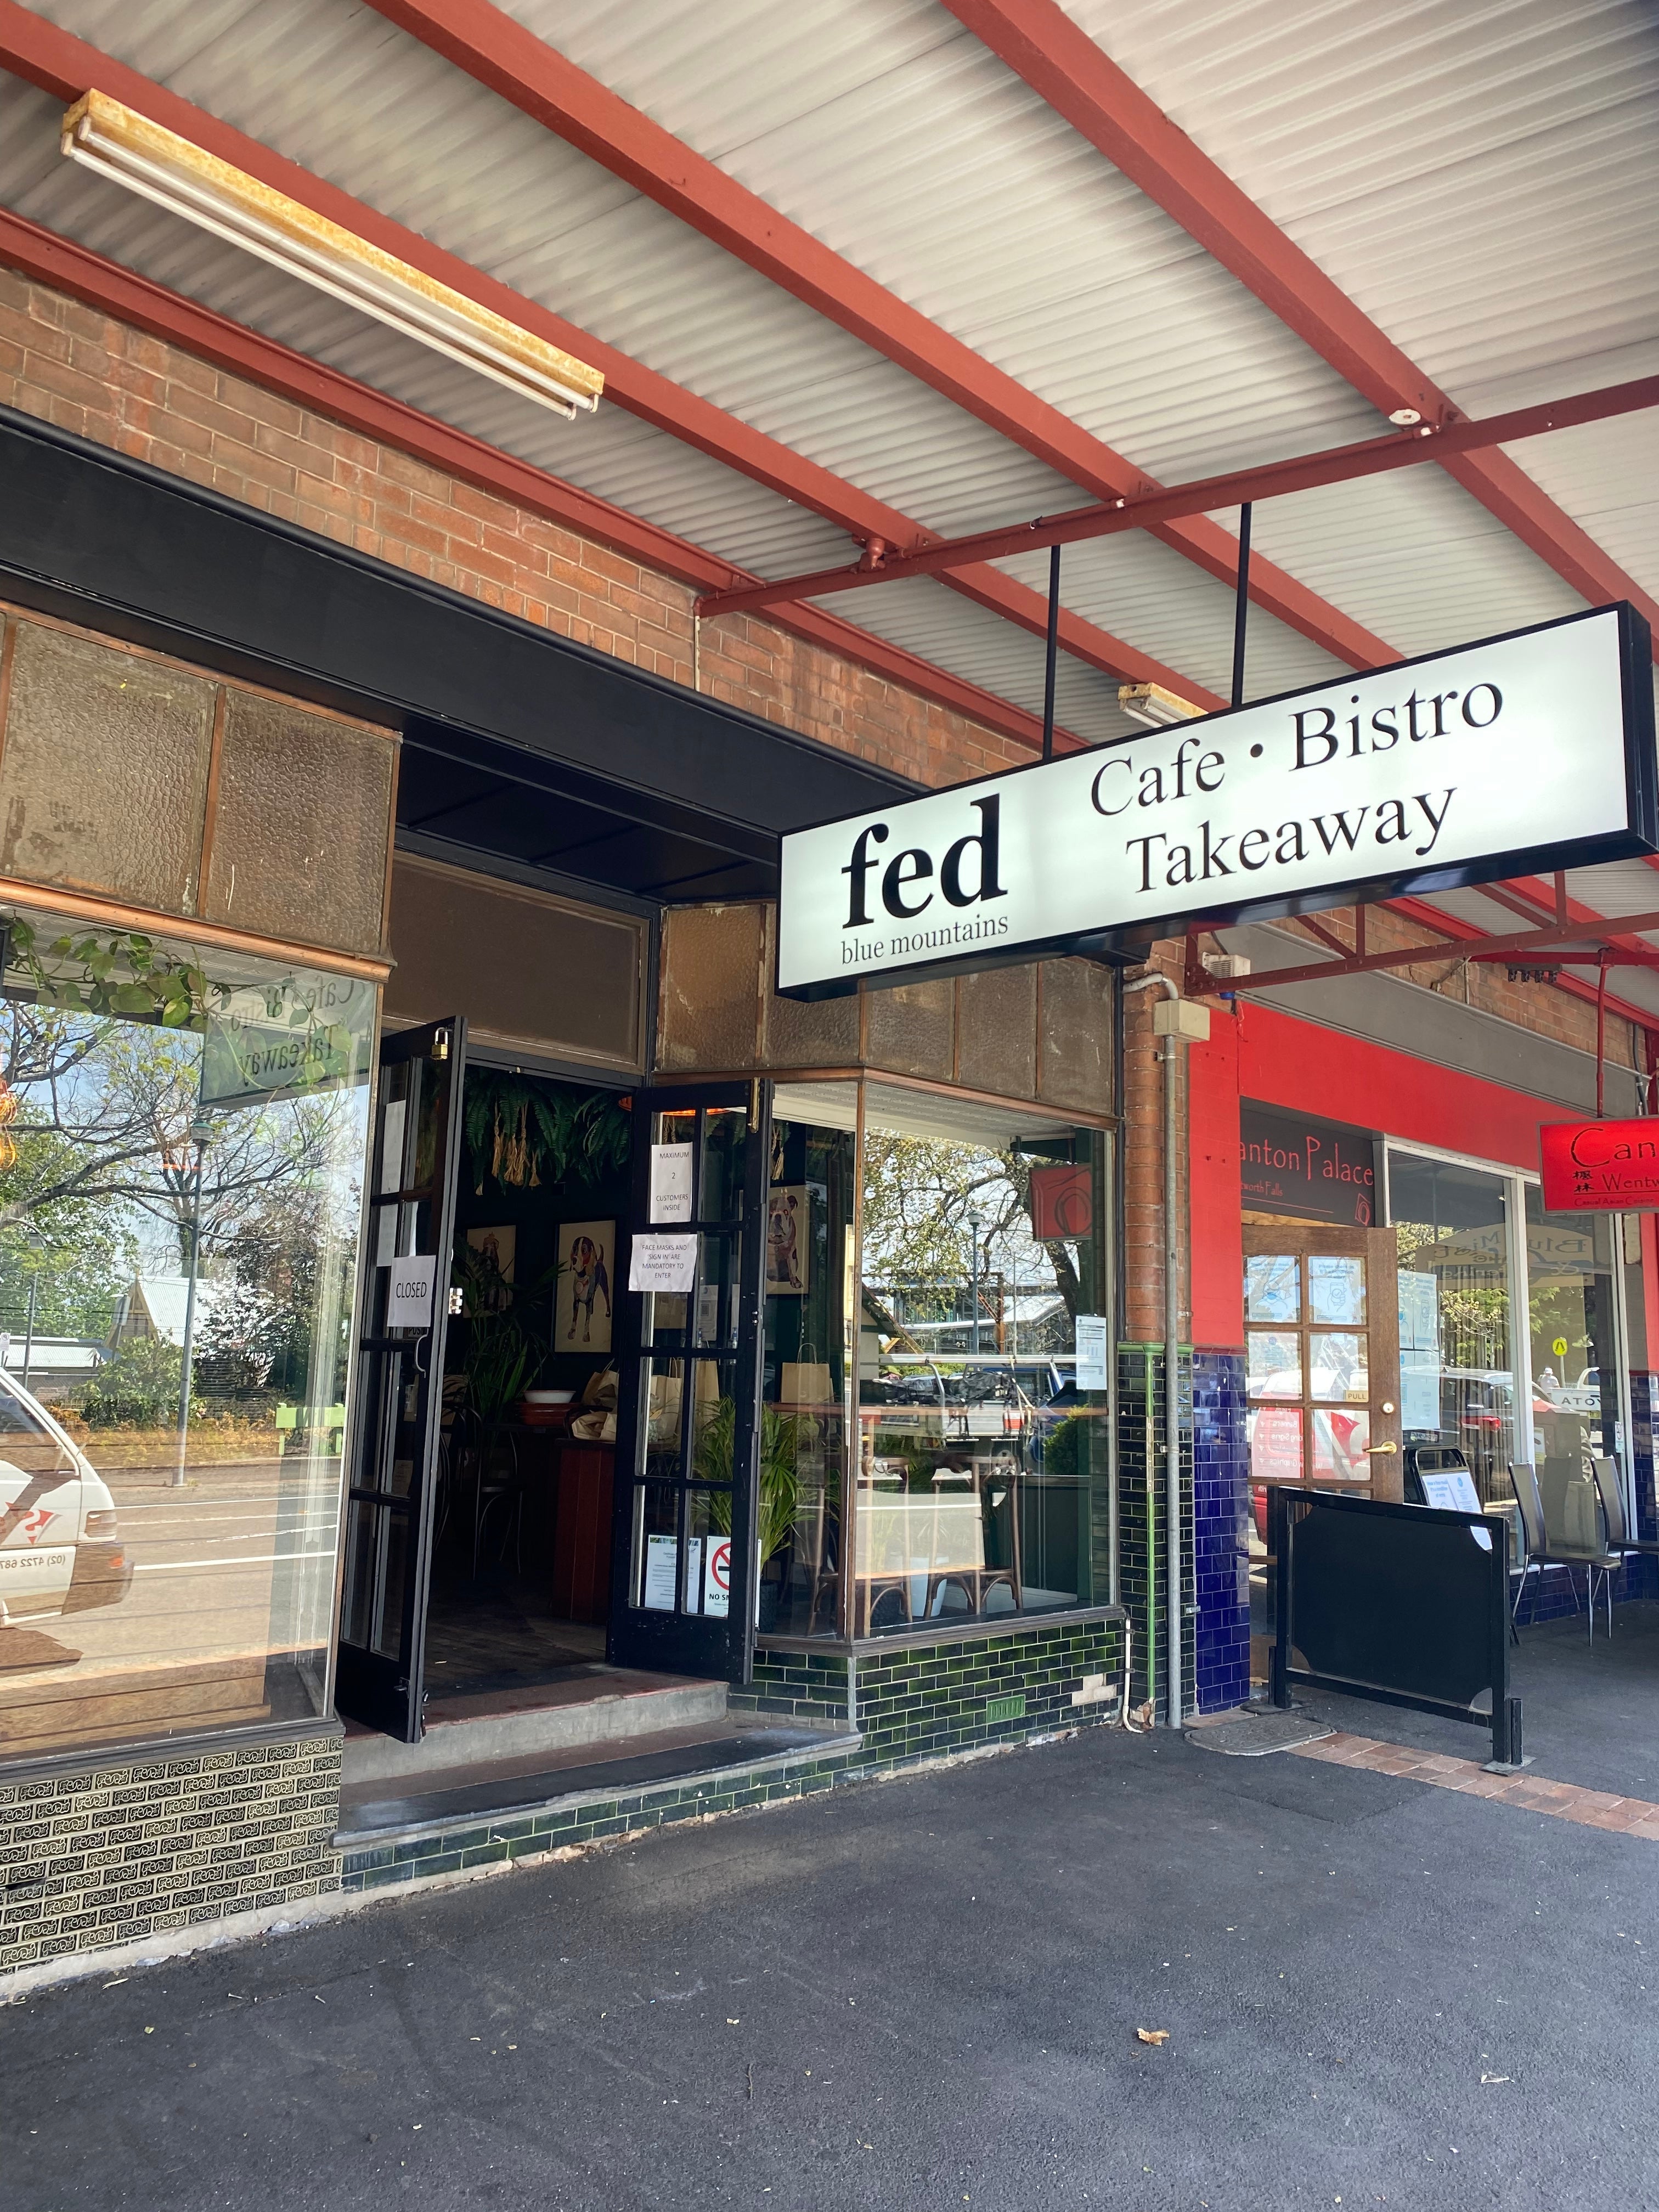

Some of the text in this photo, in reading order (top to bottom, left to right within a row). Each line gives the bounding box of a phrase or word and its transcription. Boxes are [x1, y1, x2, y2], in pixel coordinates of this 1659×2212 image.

[1091, 682, 1504, 817] Cafe Bistro
[1126, 787, 1457, 893] Takeaway
[840, 792, 1009, 929] fed
[841, 913, 1009, 965] blue mountains
[659, 1151, 690, 1159] MAXIMUM
[1239, 1136, 1374, 1186] anton Palace
[1265, 1181, 1284, 1196] Falls
[656, 1193, 689, 1201] CUSTOMERS
[663, 1203, 681, 1211] INSIDE
[396, 1282, 427, 1298] CLOSED
[409, 1327, 422, 1335] PUS
